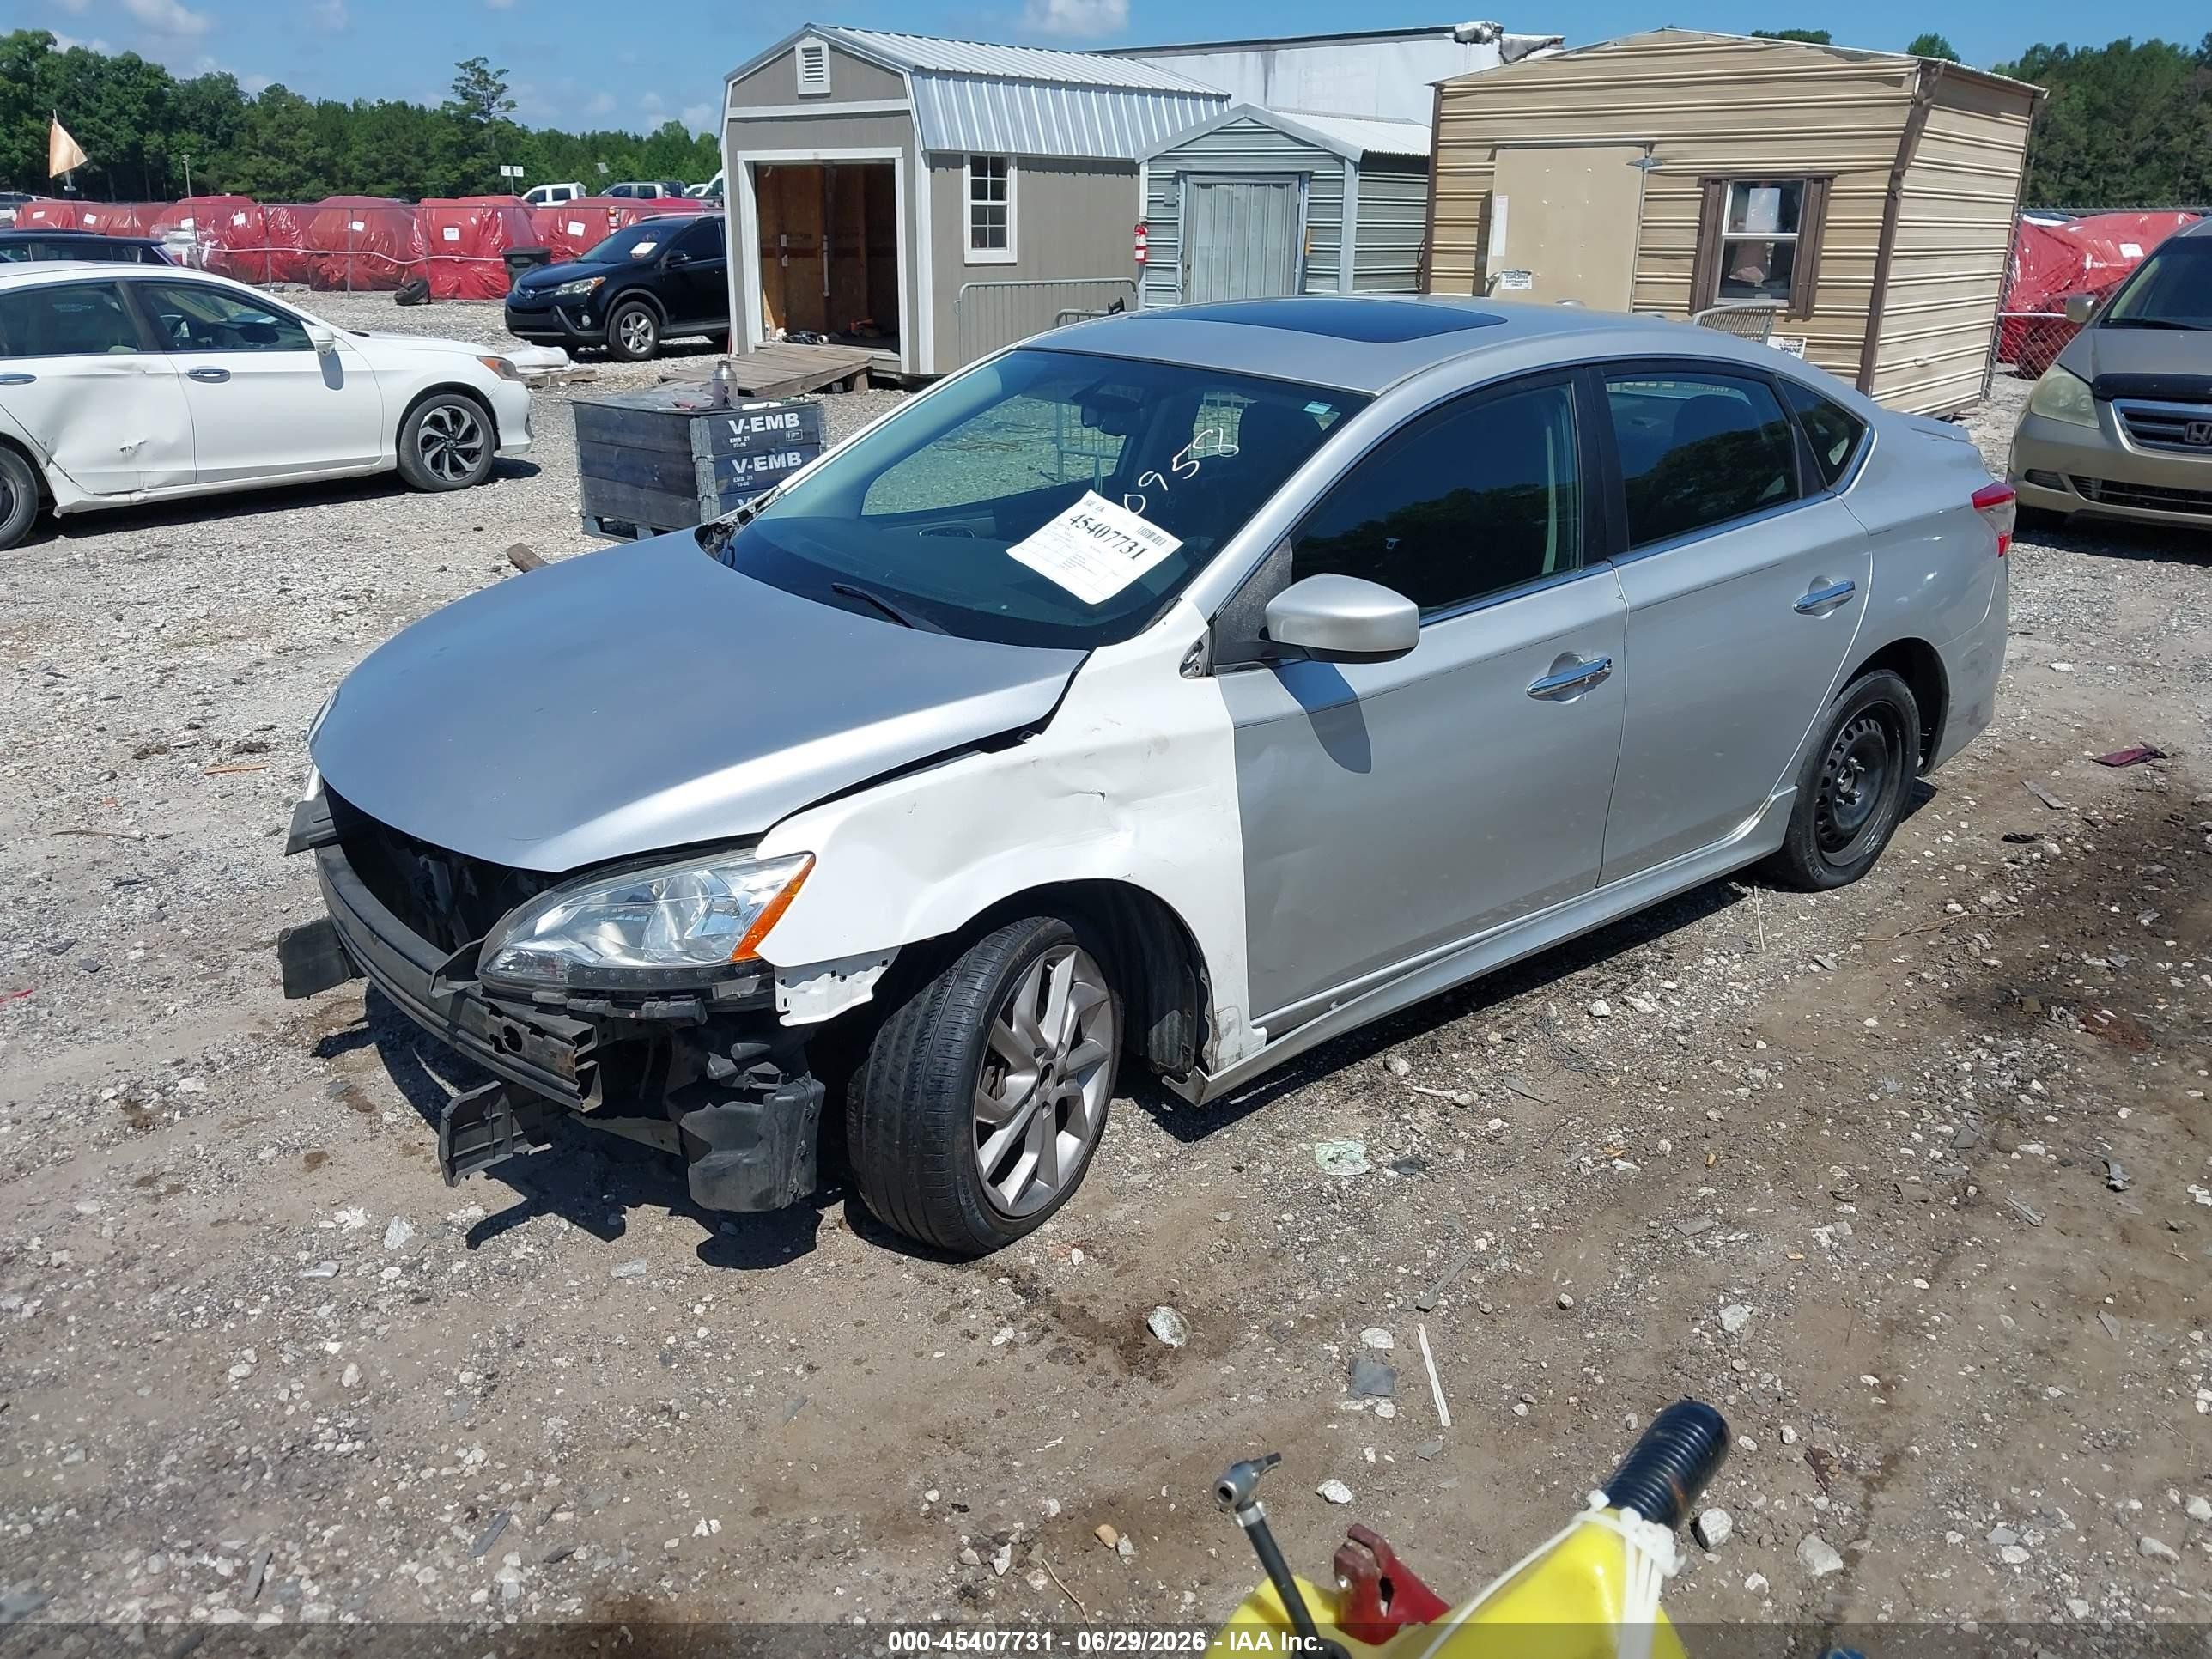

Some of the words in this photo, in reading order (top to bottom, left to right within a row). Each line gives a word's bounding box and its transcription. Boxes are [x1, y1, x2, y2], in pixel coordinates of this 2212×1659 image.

[728, 412, 800, 434] V-EMB
[731, 452, 803, 474] V-EMB
[1069, 514, 1148, 561] 45407731
